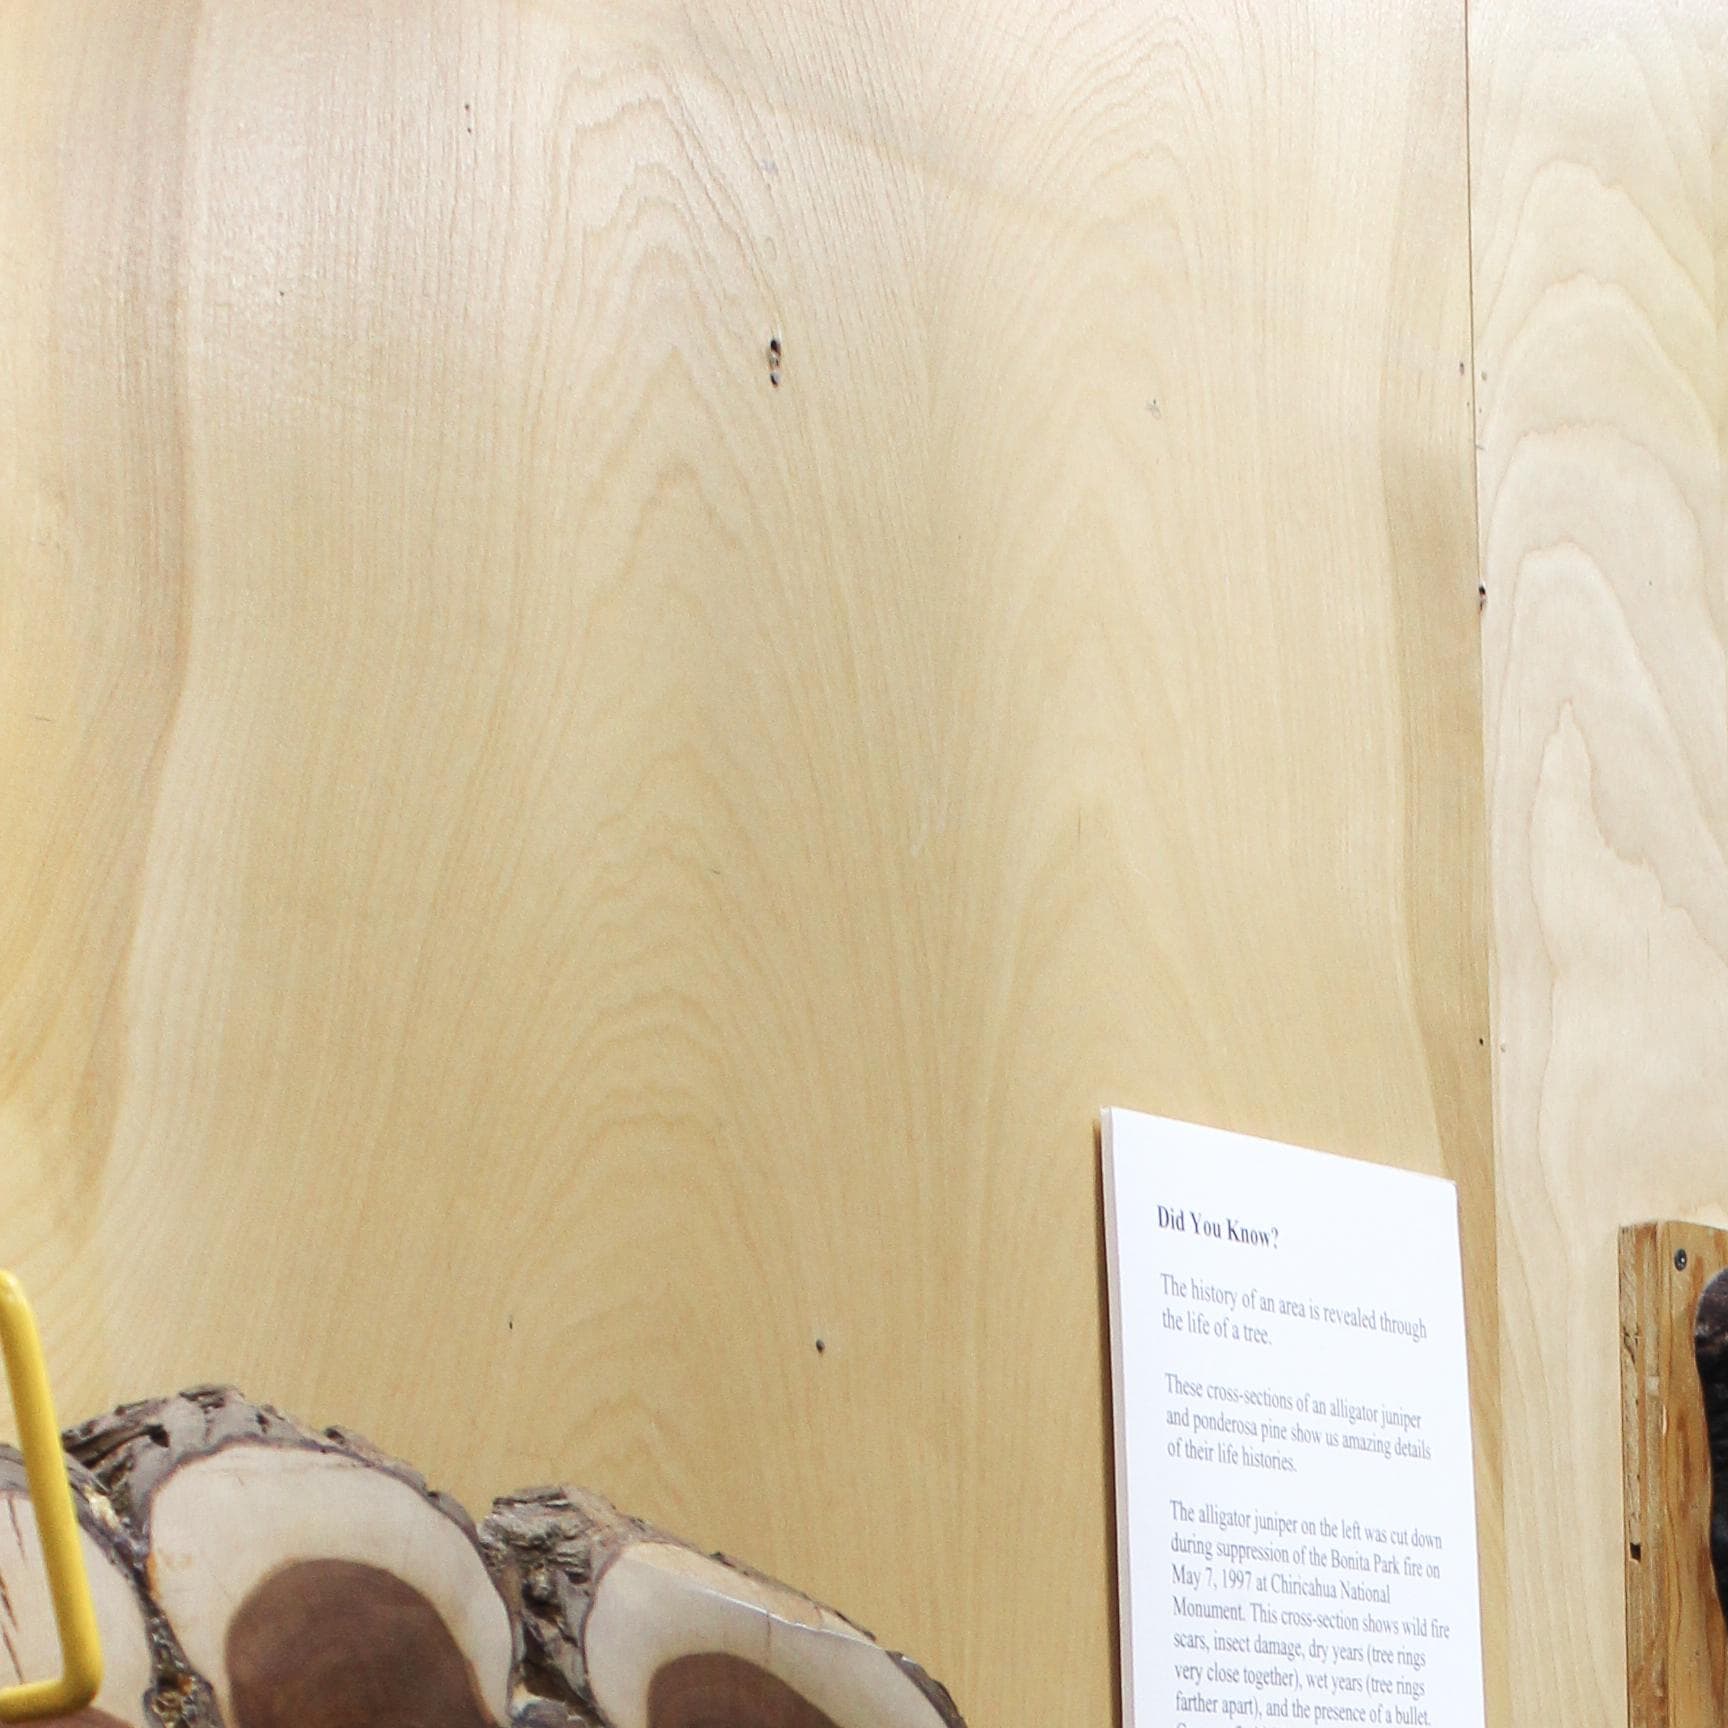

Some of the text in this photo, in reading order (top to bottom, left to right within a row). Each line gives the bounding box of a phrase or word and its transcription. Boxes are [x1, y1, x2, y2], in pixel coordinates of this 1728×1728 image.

[1156, 1204, 1279, 1249] Did You Know?
[1160, 1272, 1427, 1343] The history area revealed through
[1162, 1307, 1183, 1331] the
[1187, 1310, 1210, 1335] life
[1164, 1372, 1421, 1432] These cross-sections alligator juniper
[1166, 1407, 1431, 1460] and ponderosa pine show amazing details
[1184, 1438, 1214, 1462] their
[1217, 1442, 1238, 1464] life
[1169, 1499, 1442, 1549] The alligator juniper on the left was cut down
[1170, 1531, 1440, 1579] during suppression the Bonita Park fire on
[1171, 1562, 1201, 1591] May
[1222, 1568, 1252, 1590] 1997
[1339, 1579, 1390, 1604] National
[1251, 1602, 1278, 1624] This
[1281, 1610, 1359, 1630] cross-section
[1362, 1613, 1399, 1634] shows
[1401, 1616, 1427, 1637] wild
[1431, 1618, 1450, 1639] fire
[1173, 1629, 1426, 1671] scars, insect damage, dry years (tree rings
[1174, 1664, 1203, 1686] very
[1206, 1661, 1240, 1683] close
[1305, 1673, 1328, 1689] wet
[1331, 1675, 1363, 1695] years
[1365, 1674, 1393, 1697] (tree
[1396, 1675, 1425, 1701] rings
[1175, 1690, 1218, 1713] farther
[1265, 1697, 1289, 1717] and
[1291, 1698, 1311, 1718] the
[1314, 1705, 1366, 1725] presence
